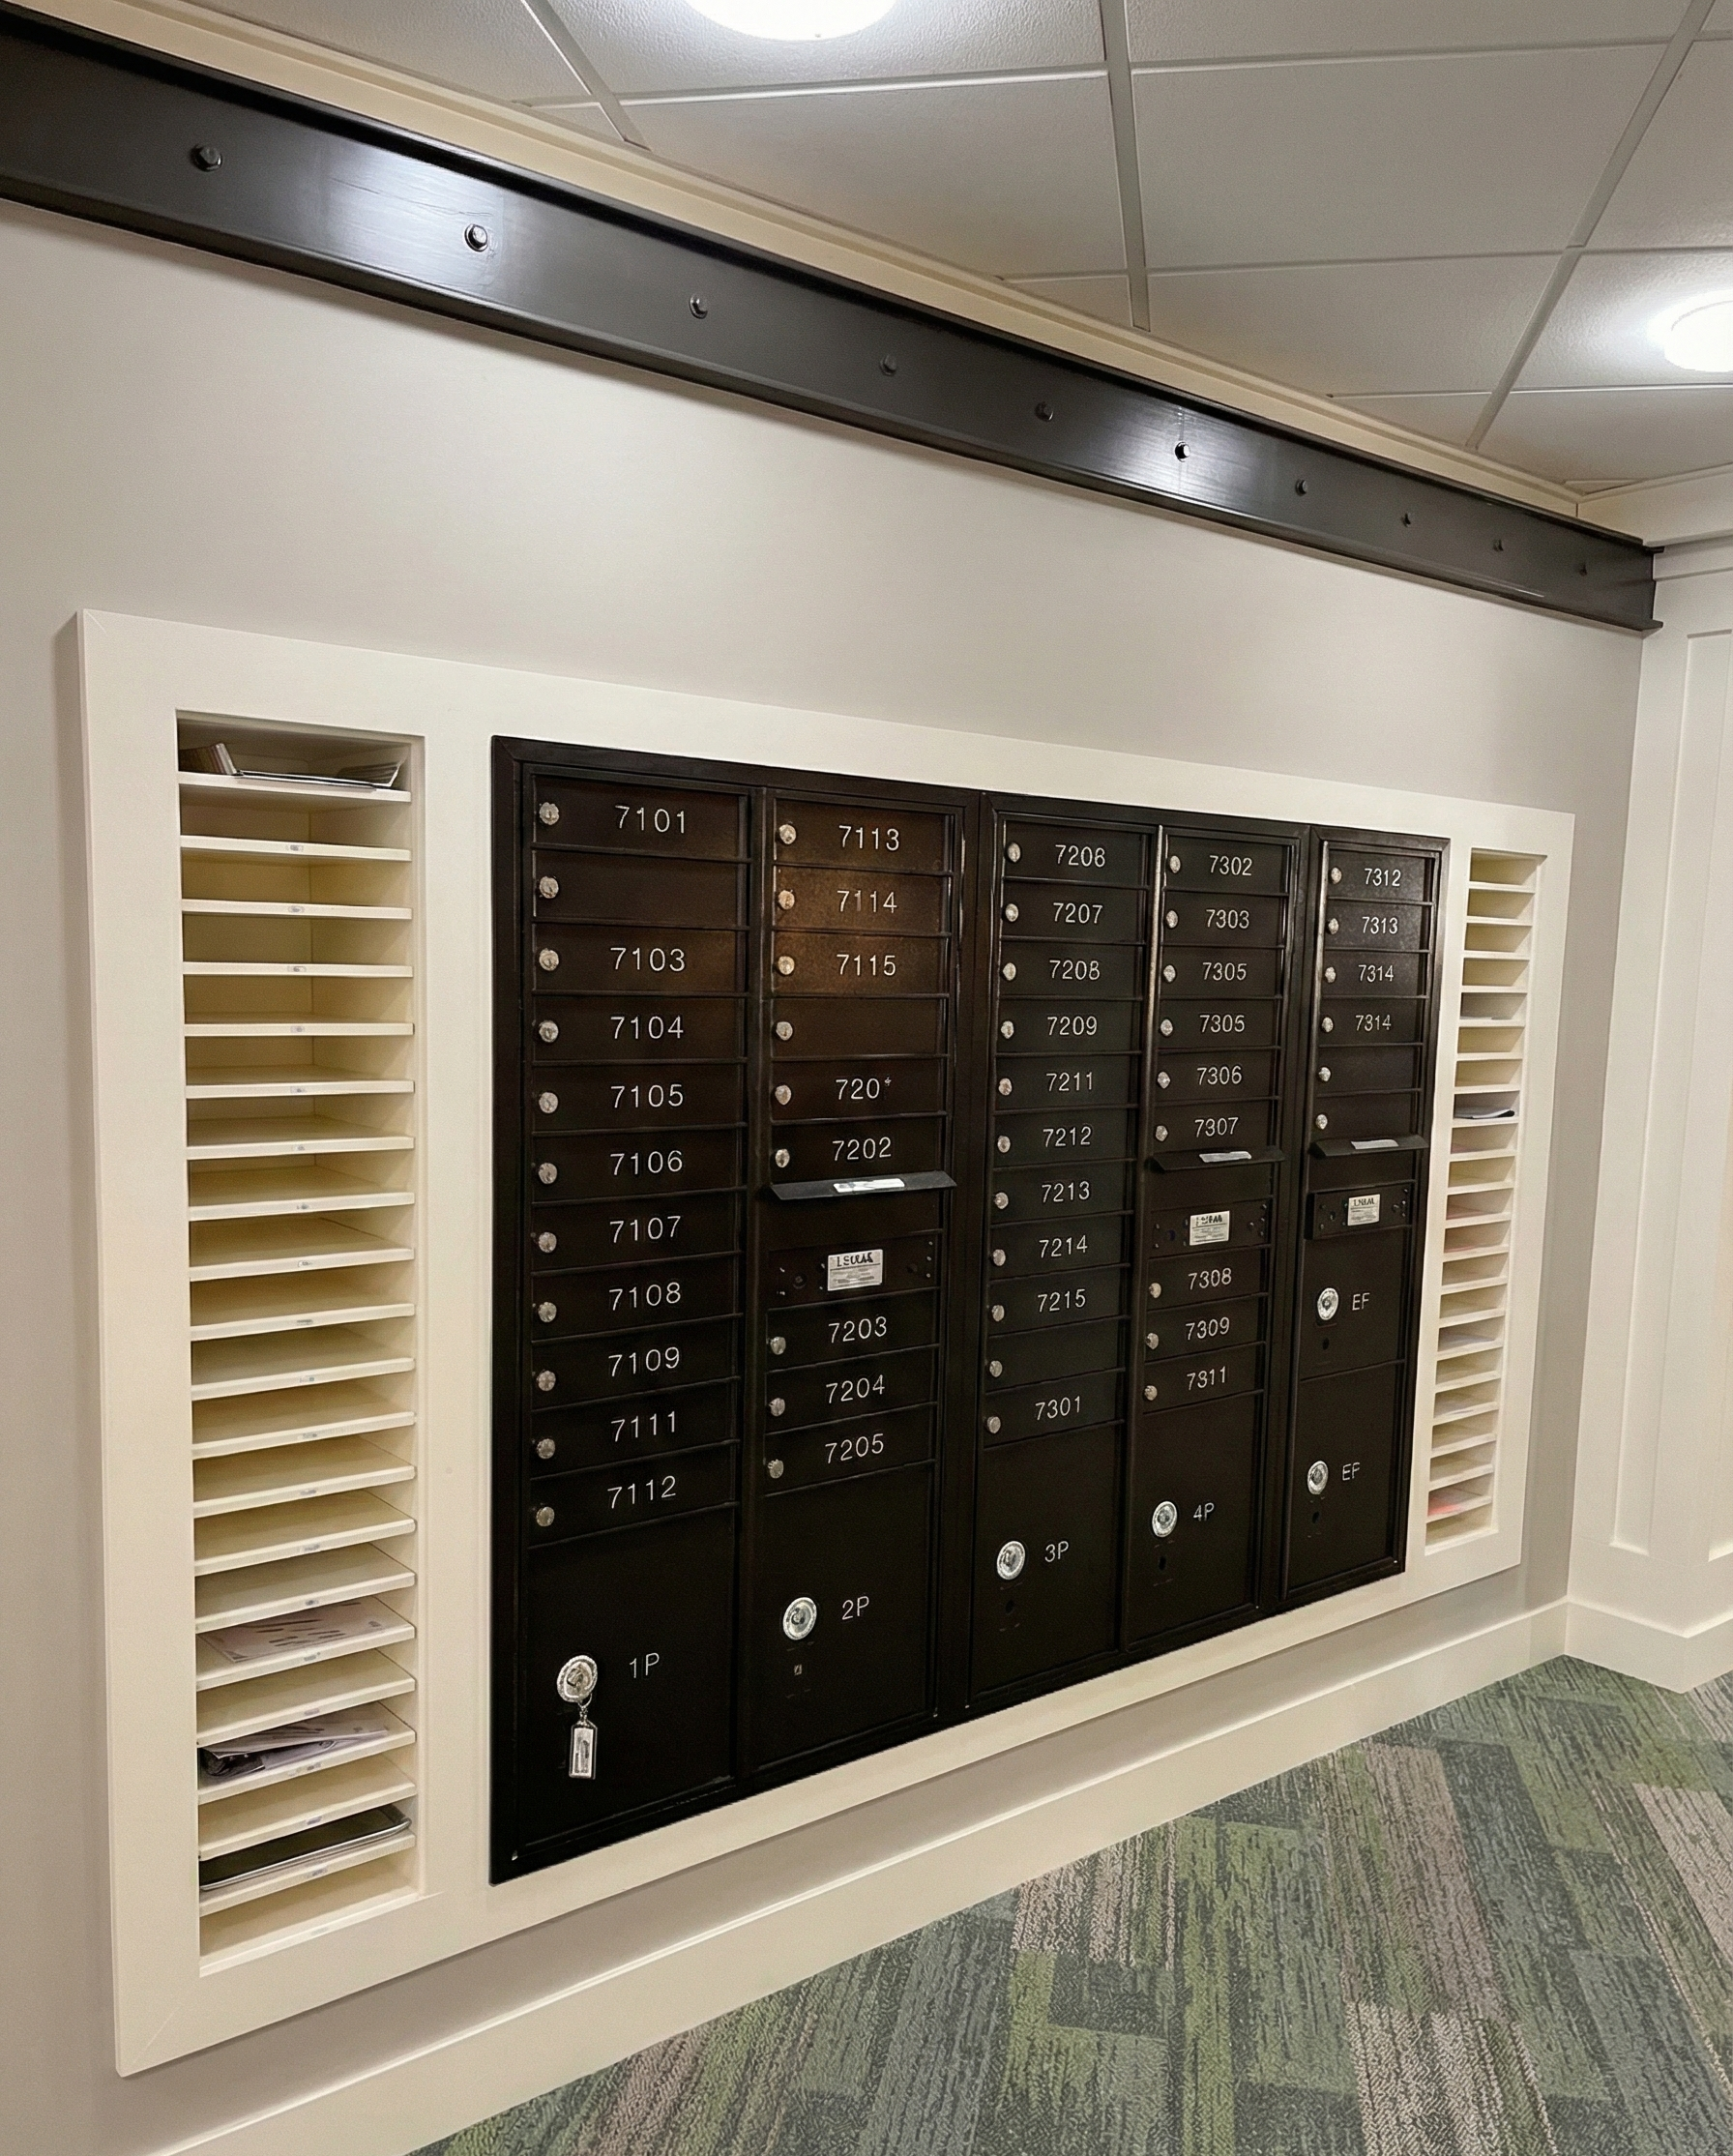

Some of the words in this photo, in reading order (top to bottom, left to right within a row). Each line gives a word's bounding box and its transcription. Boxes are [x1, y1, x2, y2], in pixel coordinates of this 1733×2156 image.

[615, 805, 685, 834] 7101
[838, 824, 899, 851] 7113
[1209, 854, 1252, 876] 7302
[1364, 868, 1401, 887] 7312
[837, 890, 897, 914] 7114
[1052, 901, 1103, 924] 7207
[1206, 908, 1249, 930] 7303
[1362, 916, 1398, 934] 7313
[610, 947, 686, 972] 7103
[836, 954, 896, 976] 7115
[1202, 961, 1248, 981] 7305
[1358, 964, 1395, 983] 7314
[610, 1016, 684, 1040] 7104
[1046, 1016, 1098, 1036] 7209
[1045, 1072, 1093, 1092] 7211
[1196, 1065, 1243, 1085] 7306
[610, 1083, 684, 1108] 7105
[836, 1077, 892, 1101] 720
[1043, 1126, 1092, 1148] 7212
[1194, 1116, 1239, 1137] 7307
[832, 1136, 892, 1162] 7202
[609, 1150, 683, 1176] 7106
[1042, 1180, 1090, 1203] 7213
[609, 1215, 682, 1244] 7107
[1039, 1234, 1088, 1258] 7214
[1188, 1267, 1232, 1290] 7308
[608, 1282, 682, 1312] 7108
[1037, 1288, 1086, 1313] 7215
[1351, 1292, 1370, 1312] EF
[828, 1315, 887, 1344] 7203
[1185, 1316, 1230, 1341] 7309
[607, 1346, 680, 1377] 7109
[825, 1373, 886, 1404] 7204
[1035, 1395, 1080, 1421] 7301
[610, 1410, 675, 1442] 7111
[824, 1432, 884, 1464] 7205
[606, 1475, 677, 1510] 7112
[1192, 1502, 1215, 1520] 4P
[1044, 1540, 1070, 1563] 3P
[841, 1595, 869, 1620] 2P
[629, 1652, 661, 1679] 1P
